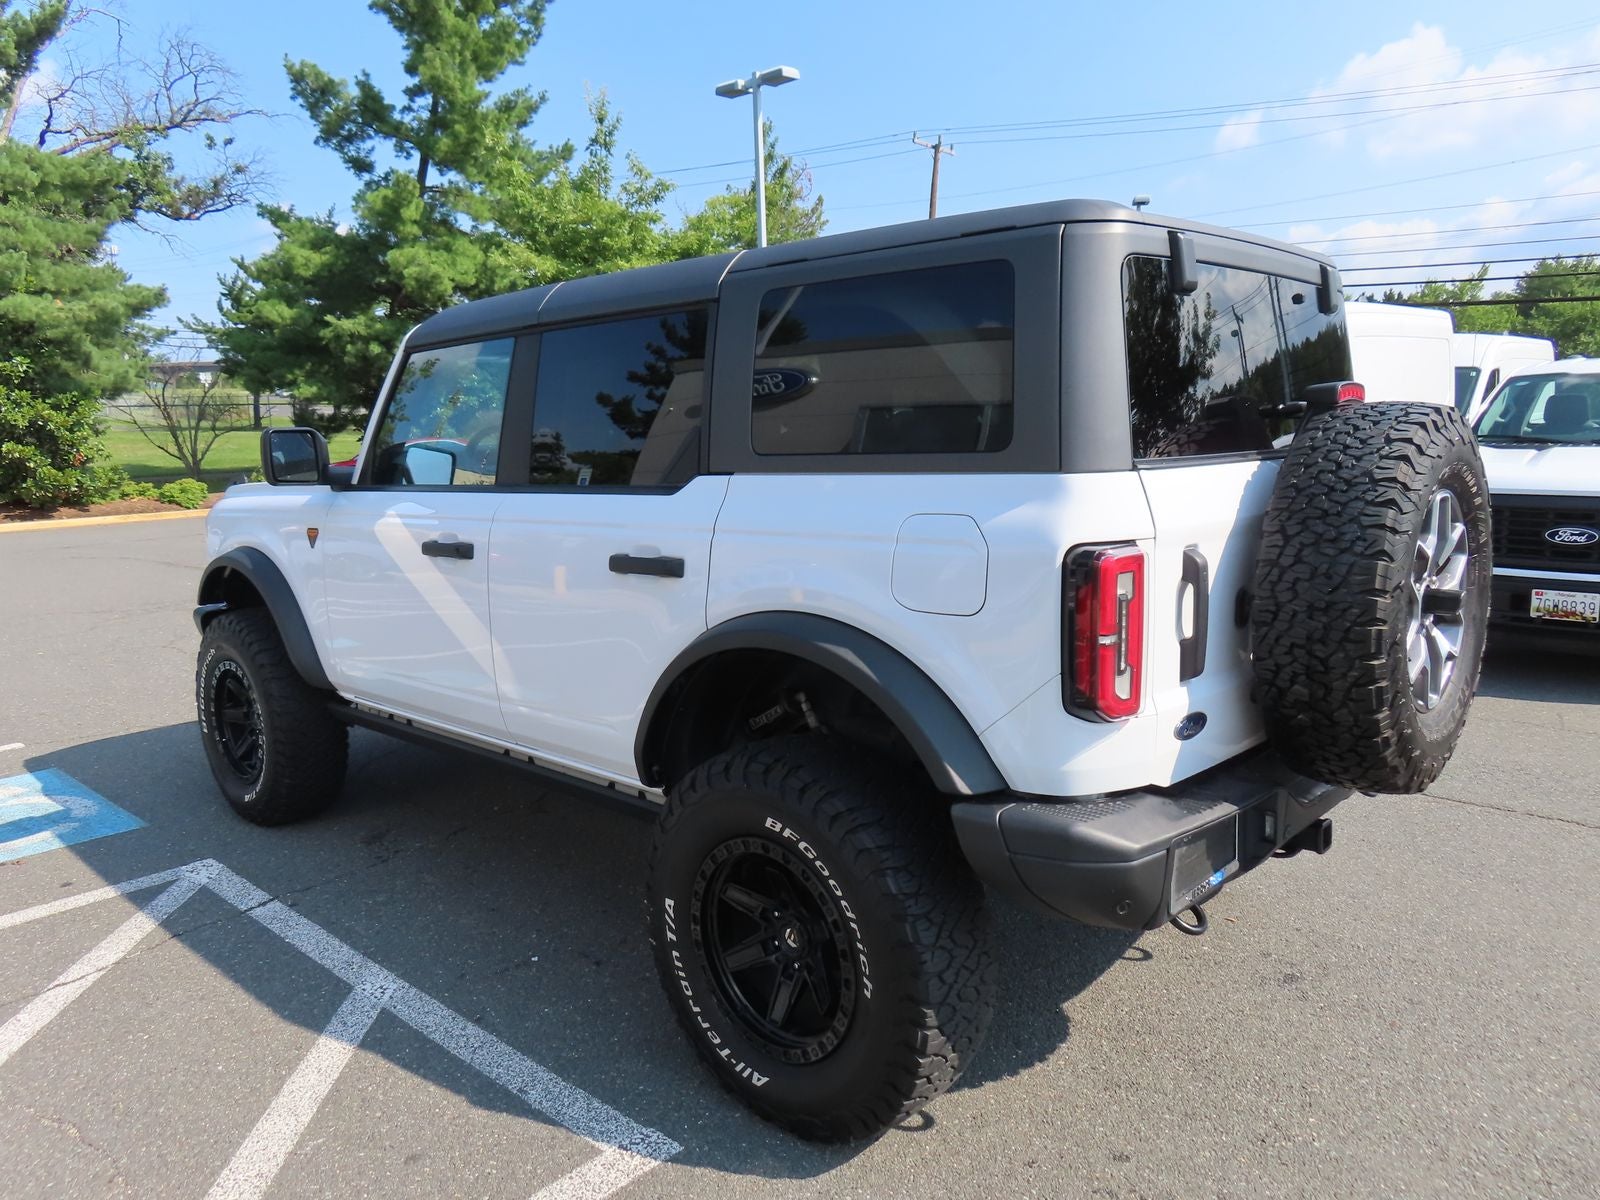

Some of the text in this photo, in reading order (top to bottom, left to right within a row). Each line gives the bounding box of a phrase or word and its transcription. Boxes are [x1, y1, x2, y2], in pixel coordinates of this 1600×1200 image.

[1555, 529, 1587, 543] Ford
[664, 897, 770, 1088] All-Terrain T/A
[764, 816, 873, 1000] BFGoodrich
